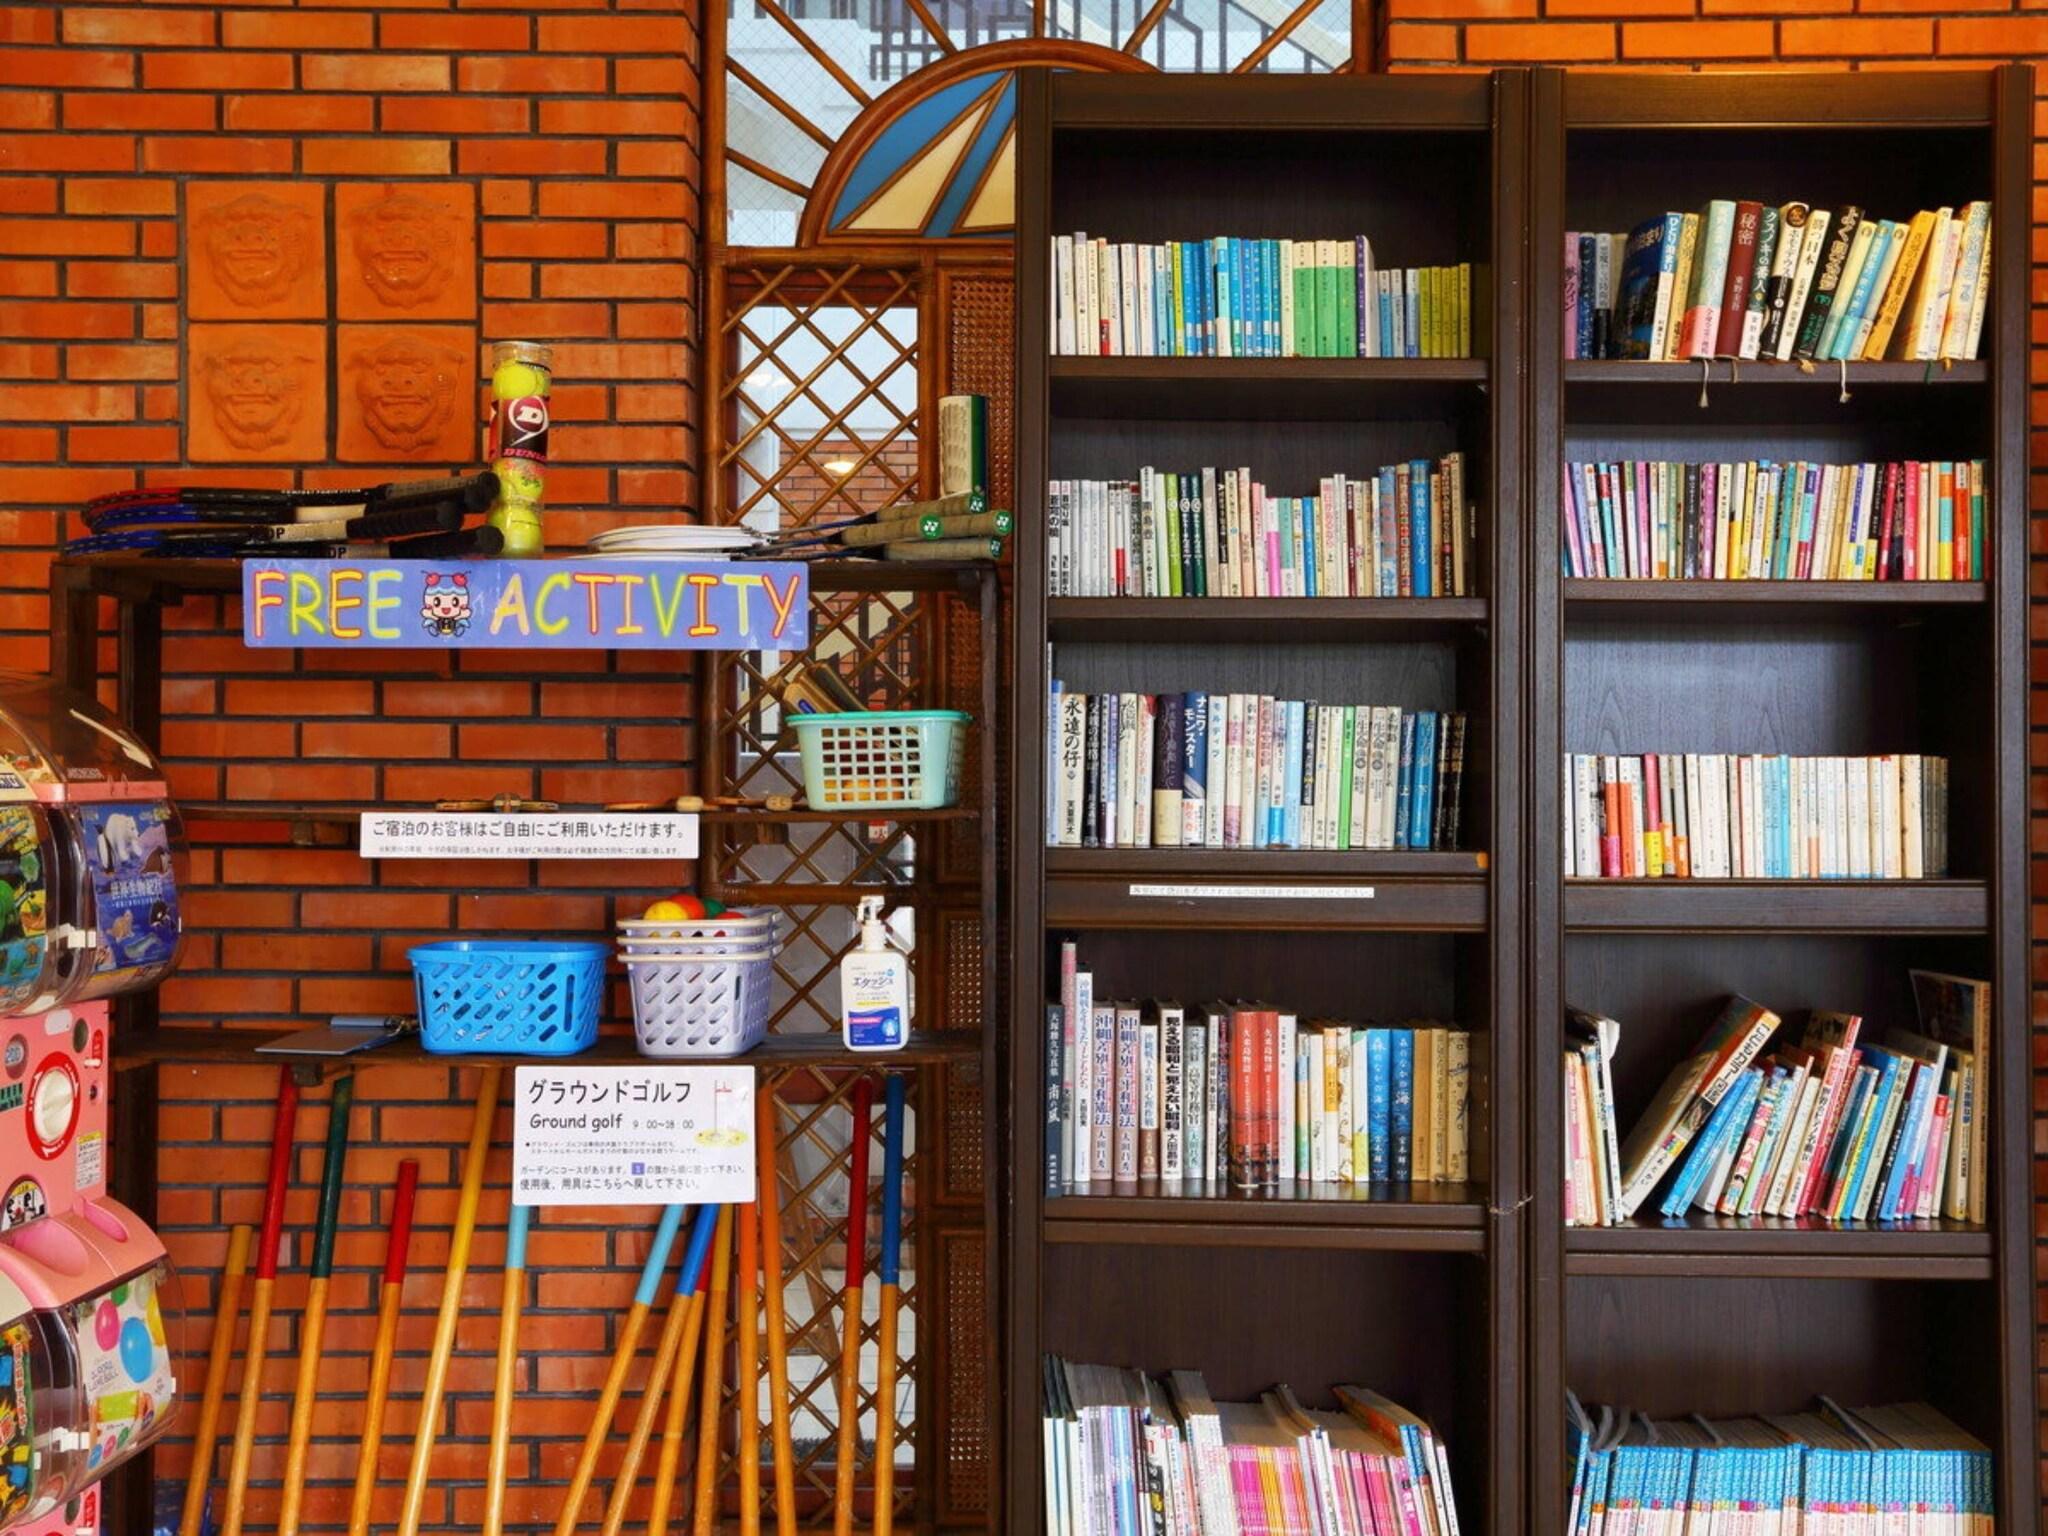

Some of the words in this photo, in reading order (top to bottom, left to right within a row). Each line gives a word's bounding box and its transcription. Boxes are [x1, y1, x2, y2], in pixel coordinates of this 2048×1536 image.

[1738, 213, 1754, 246] 秘密
[1753, 211, 1778, 292] クスノキの番人
[252, 568, 404, 639] FREE
[488, 570, 801, 639] ACTIVITY
[1062, 697, 1083, 768] 永遠の仔
[1184, 708, 1196, 768] モンスター
[372, 820, 685, 838] ご宿泊のお客様はご自由にご利用いただけます。
[528, 1079, 692, 1105] グラウンドゴルフ
[529, 1113, 587, 1131] Ground
[591, 1113, 623, 1132] golf
[520, 1178, 700, 1191] 使用後、用具はこちらへ戻して下さい。
